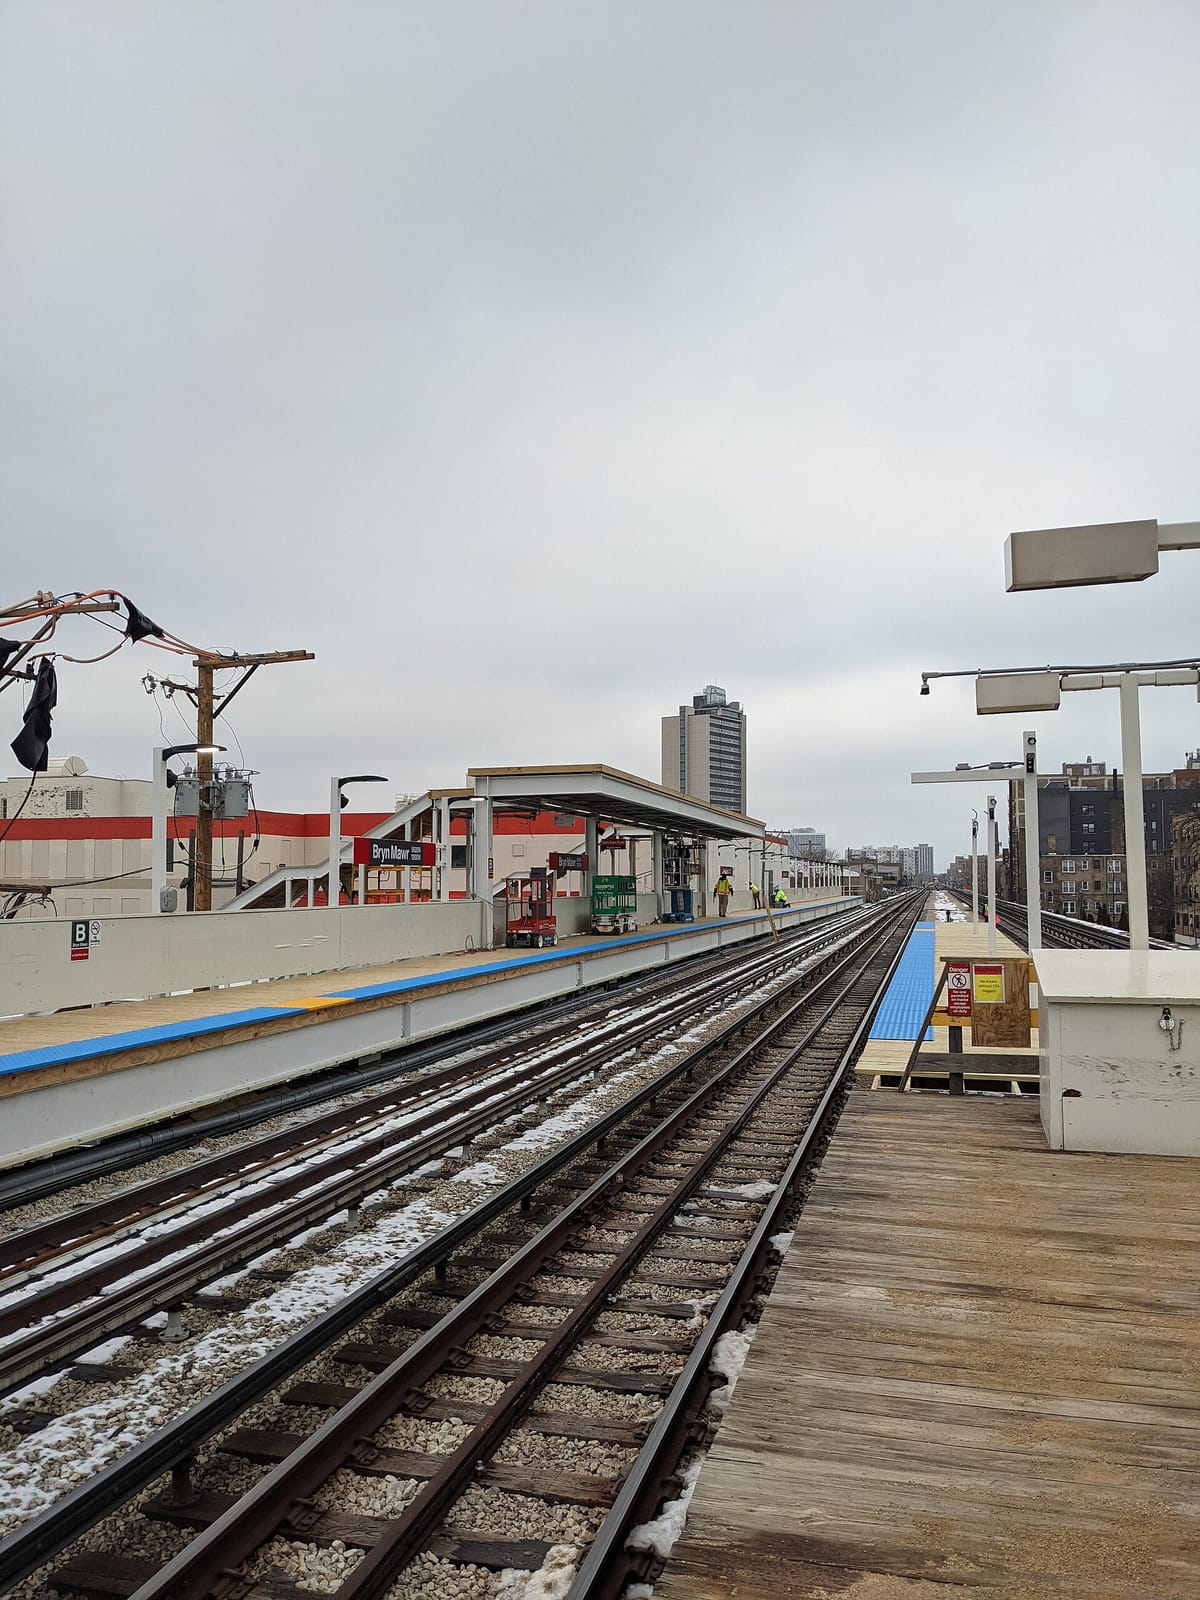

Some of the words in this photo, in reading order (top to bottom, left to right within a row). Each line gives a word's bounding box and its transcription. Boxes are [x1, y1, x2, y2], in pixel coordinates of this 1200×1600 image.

[372, 843, 390, 864] Bryn
[390, 844, 410, 861] Mawr
[75, 923, 86, 942] B
